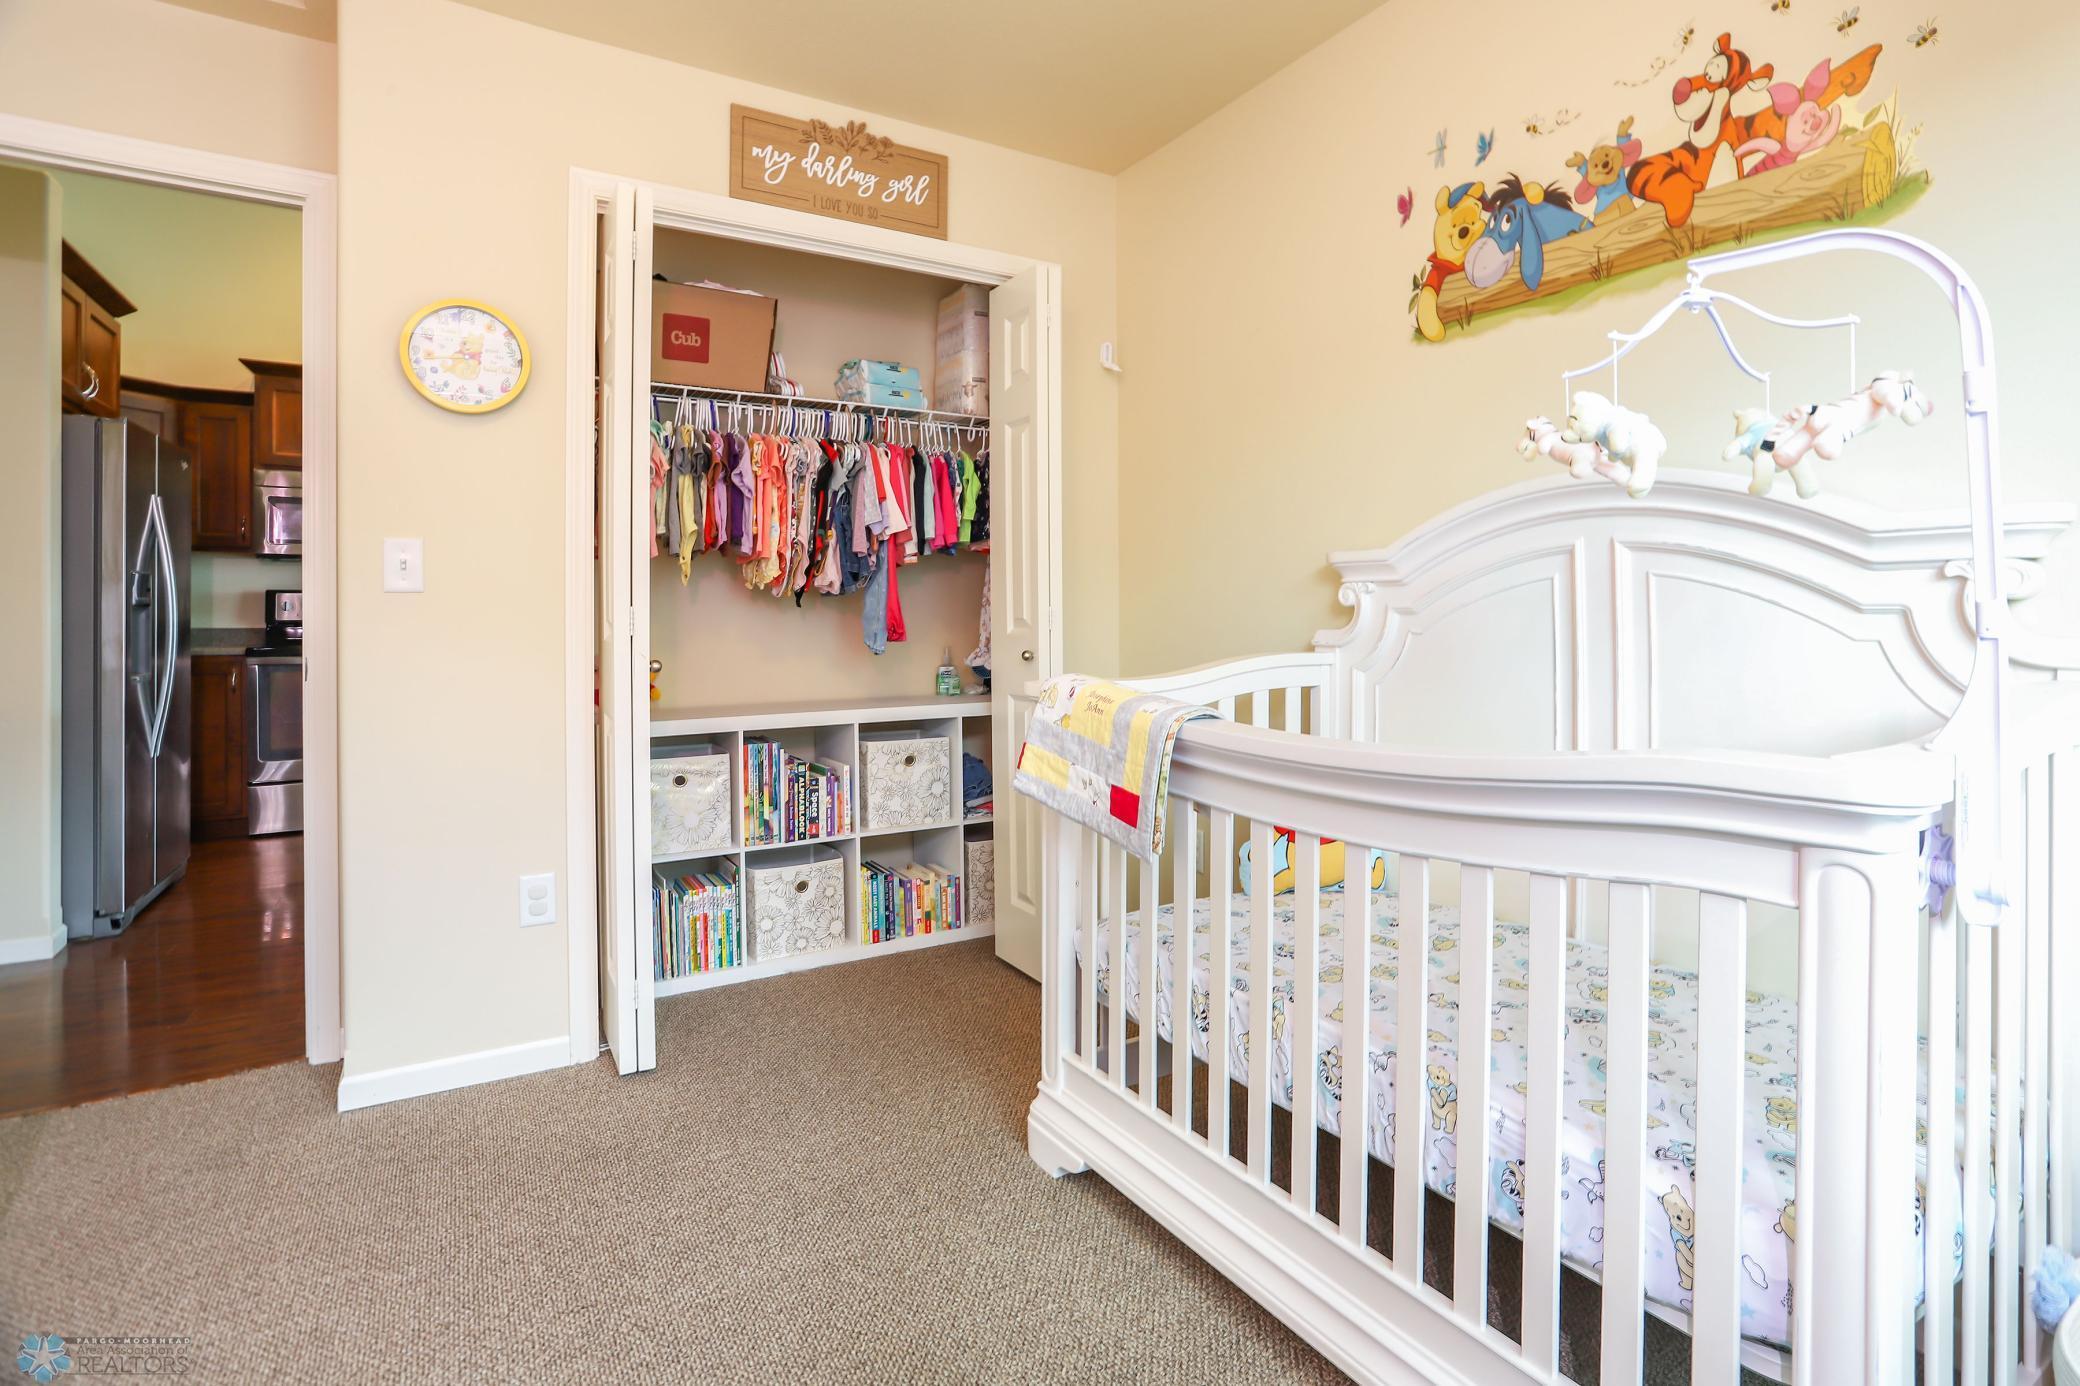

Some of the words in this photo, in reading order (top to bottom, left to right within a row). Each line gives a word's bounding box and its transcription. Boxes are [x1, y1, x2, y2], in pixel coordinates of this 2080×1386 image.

[751, 144, 796, 185] my
[801, 142, 880, 198] darling
[881, 175, 930, 206] girl
[812, 195, 818, 209] I
[820, 196, 843, 214] LOVE
[845, 201, 865, 218] YOU
[867, 206, 879, 220] SO
[670, 330, 702, 347] Cub
[810, 791, 819, 817] Space
